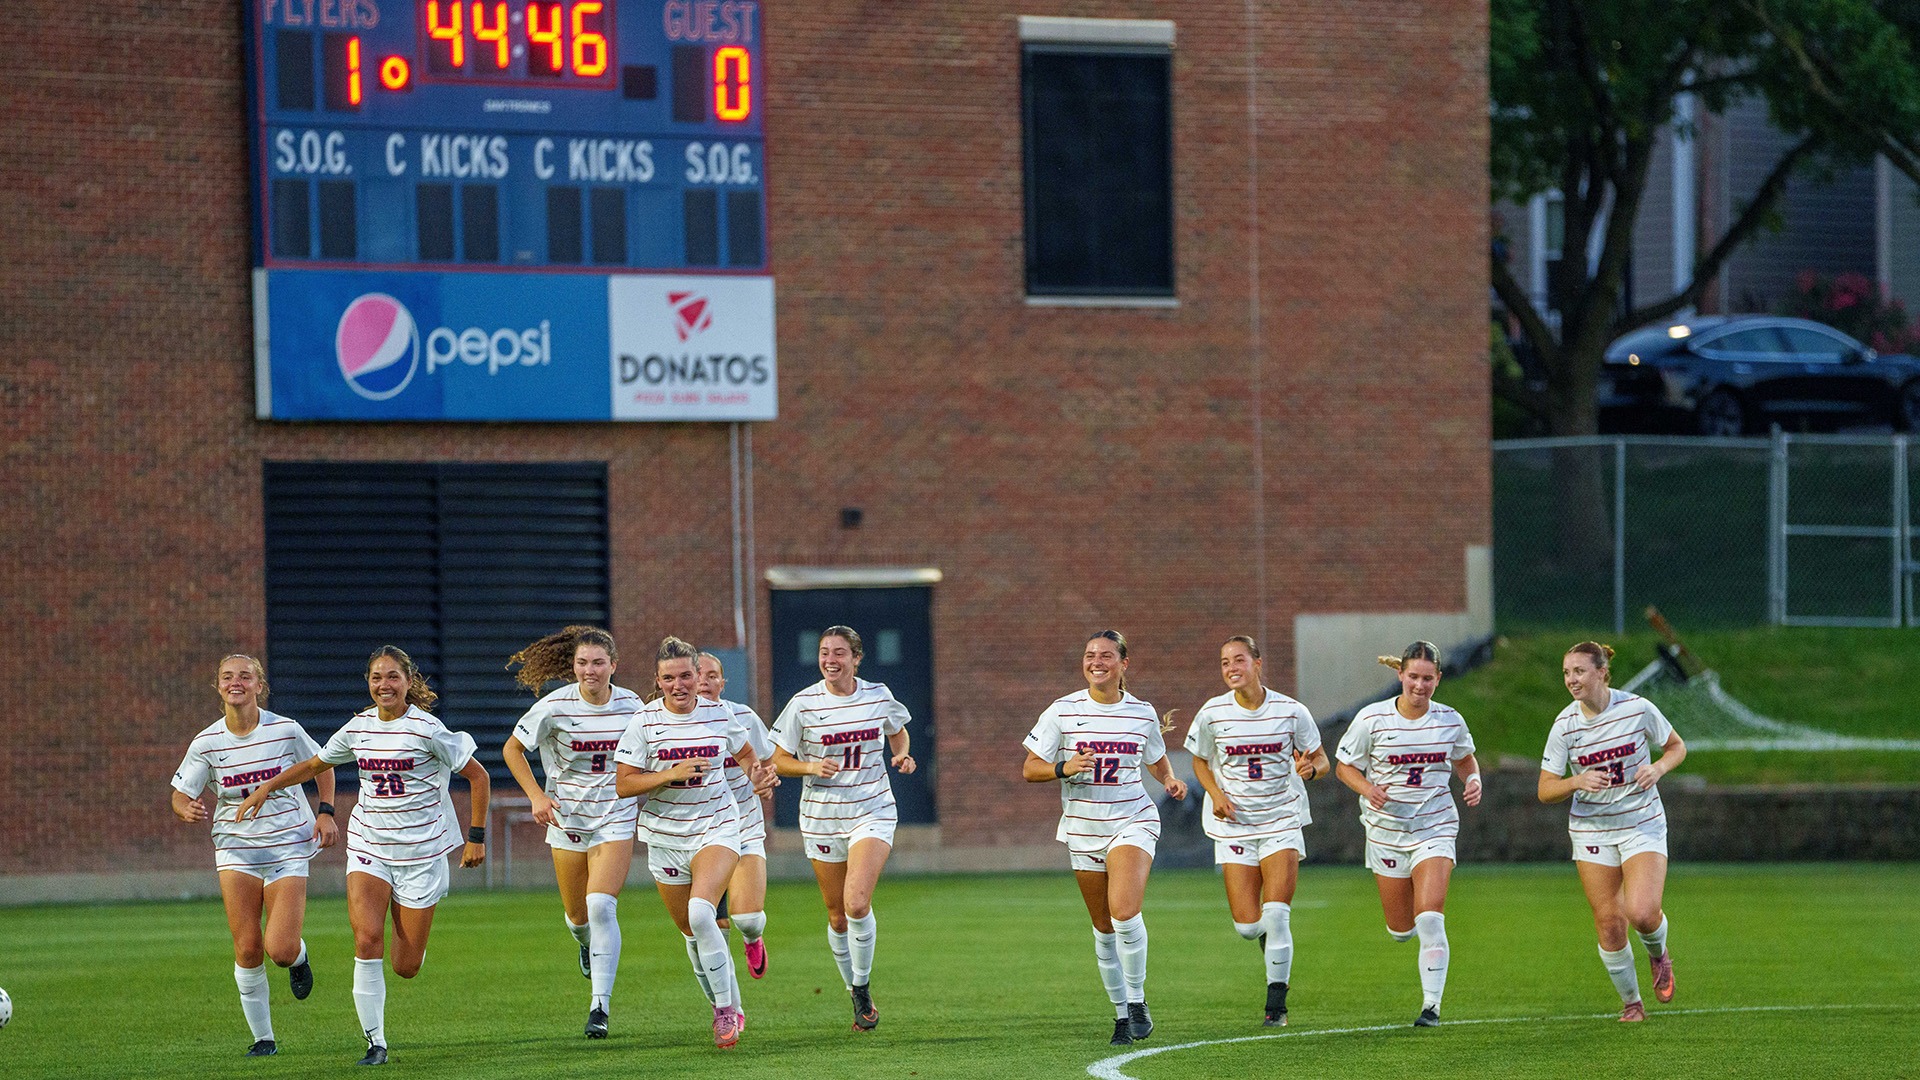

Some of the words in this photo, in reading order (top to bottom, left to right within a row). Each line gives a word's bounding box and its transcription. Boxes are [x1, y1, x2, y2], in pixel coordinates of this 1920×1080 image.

[663, 0, 754, 42] GUEST
[427, 0, 607, 76] 44:46
[346, 36, 361, 105] 1
[713, 46, 750, 121] 0
[275, 130, 353, 174] S.O.G.
[385, 133, 406, 176] C
[420, 134, 509, 179] KICKS
[534, 138, 555, 179] C
[568, 139, 655, 182] KICKS
[684, 142, 759, 184] S.O.G.
[426, 320, 551, 376] pepsi
[619, 353, 769, 386] DONATOS
[571, 740, 620, 752] DAYTO
[820, 727, 880, 746] DAYTON
[1225, 742, 1283, 757] DAYTON
[358, 758, 415, 771] DAYTON
[592, 754, 607, 772] 9
[657, 745, 719, 761] DAYTON
[843, 745, 861, 769] 11
[1387, 751, 1447, 766] DAYTON
[1577, 741, 1636, 767] DAYTON
[1093, 757, 1120, 783] 12
[1247, 757, 1263, 779] 5
[371, 773, 406, 796] 20
